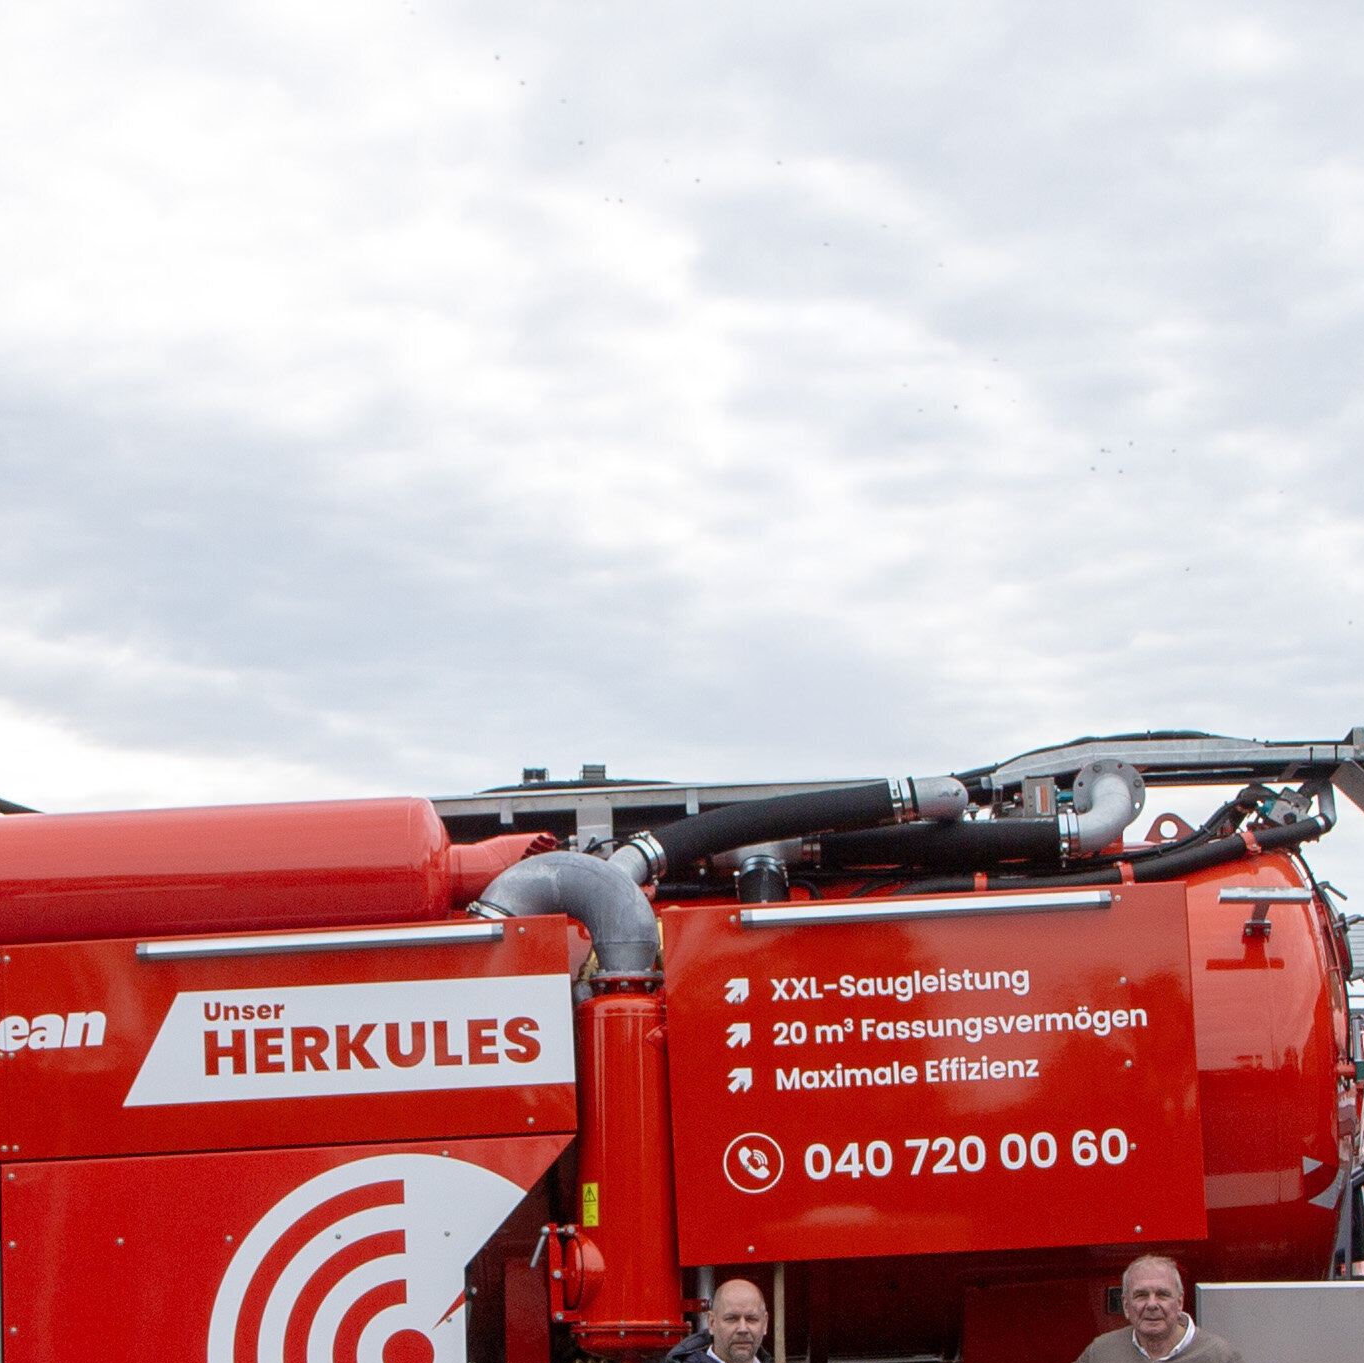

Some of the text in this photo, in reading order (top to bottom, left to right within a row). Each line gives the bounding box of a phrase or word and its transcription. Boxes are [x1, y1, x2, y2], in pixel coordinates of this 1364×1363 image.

[770, 968, 1030, 1002] XXL-Saugleistung
[204, 1002, 285, 1021] Unser
[772, 1006, 1148, 1046] 20 m³ Fassungsvermögen
[203, 1016, 541, 1076] HERKULES
[775, 1055, 1039, 1091] Maximale Effizienz
[804, 1128, 1129, 1180] 040 720 00 60
